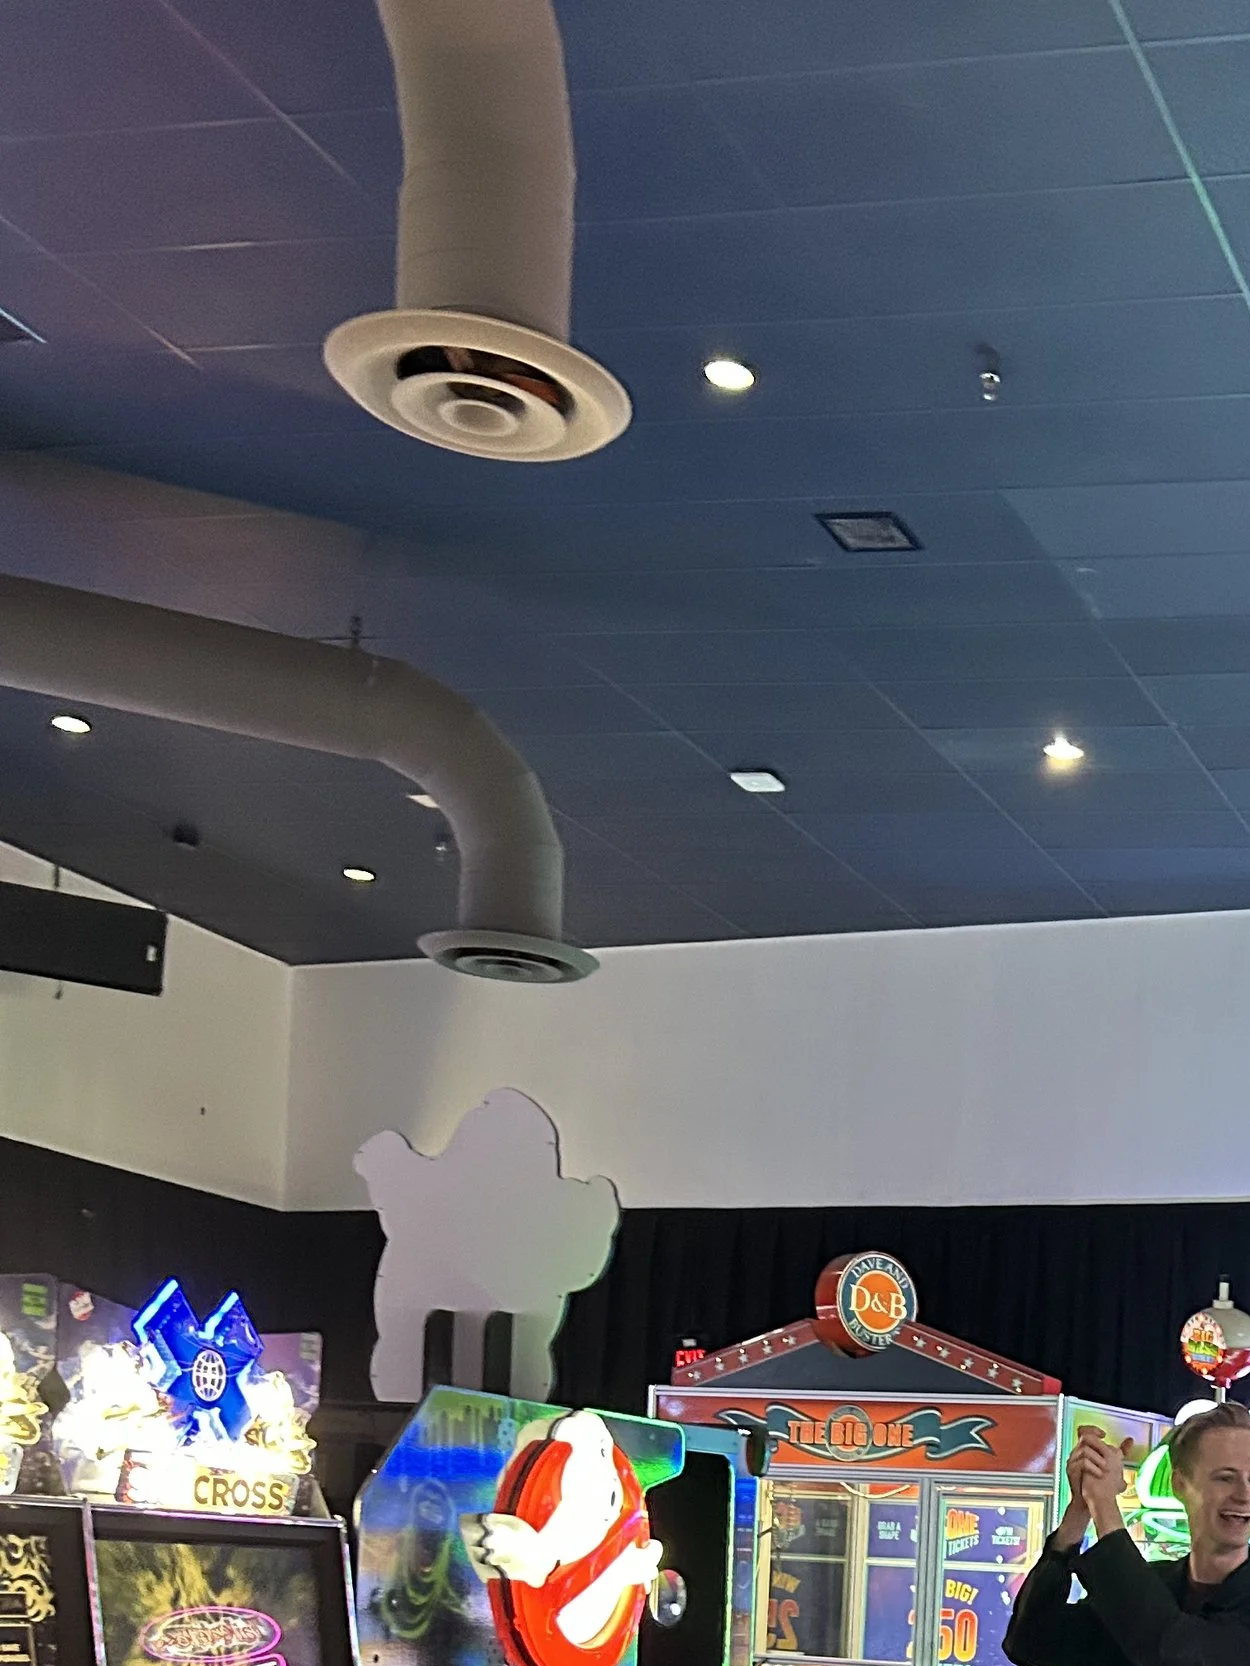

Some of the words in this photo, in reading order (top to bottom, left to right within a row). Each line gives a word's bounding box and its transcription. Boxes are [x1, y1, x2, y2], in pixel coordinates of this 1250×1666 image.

[852, 1258, 884, 1278] DAVE
[885, 1263, 909, 1289] AND
[849, 1284, 907, 1320] D&B
[788, 1420, 826, 1444] THE
[831, 1421, 867, 1446] BIG
[873, 1422, 914, 1448] ONE
[194, 1475, 284, 1511] CROSS
[947, 1508, 980, 1540] ONE
[944, 1578, 979, 1606] BIG!
